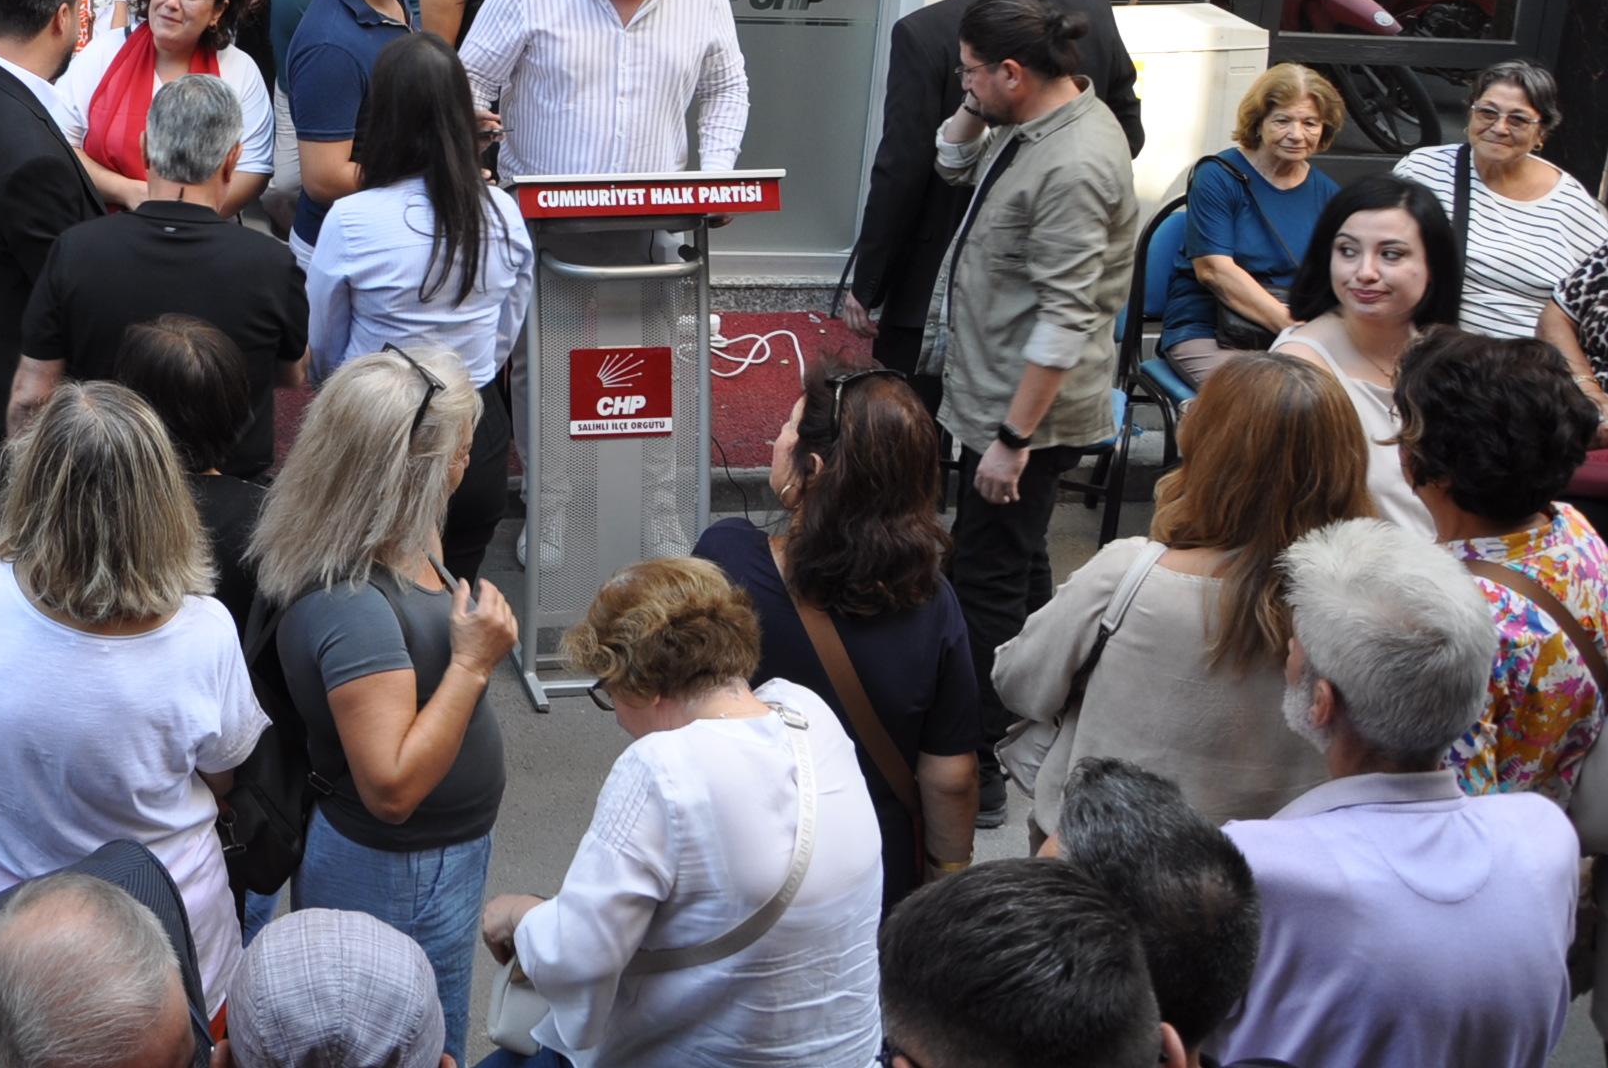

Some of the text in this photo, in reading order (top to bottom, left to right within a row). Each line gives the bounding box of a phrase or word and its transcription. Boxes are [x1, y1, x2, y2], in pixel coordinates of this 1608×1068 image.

[537, 181, 763, 209] CUMHURİYET HALK PARTİSİ
[596, 395, 646, 416] CHP
[577, 421, 610, 432] SALİHLİ
[611, 420, 629, 433] İLÇE
